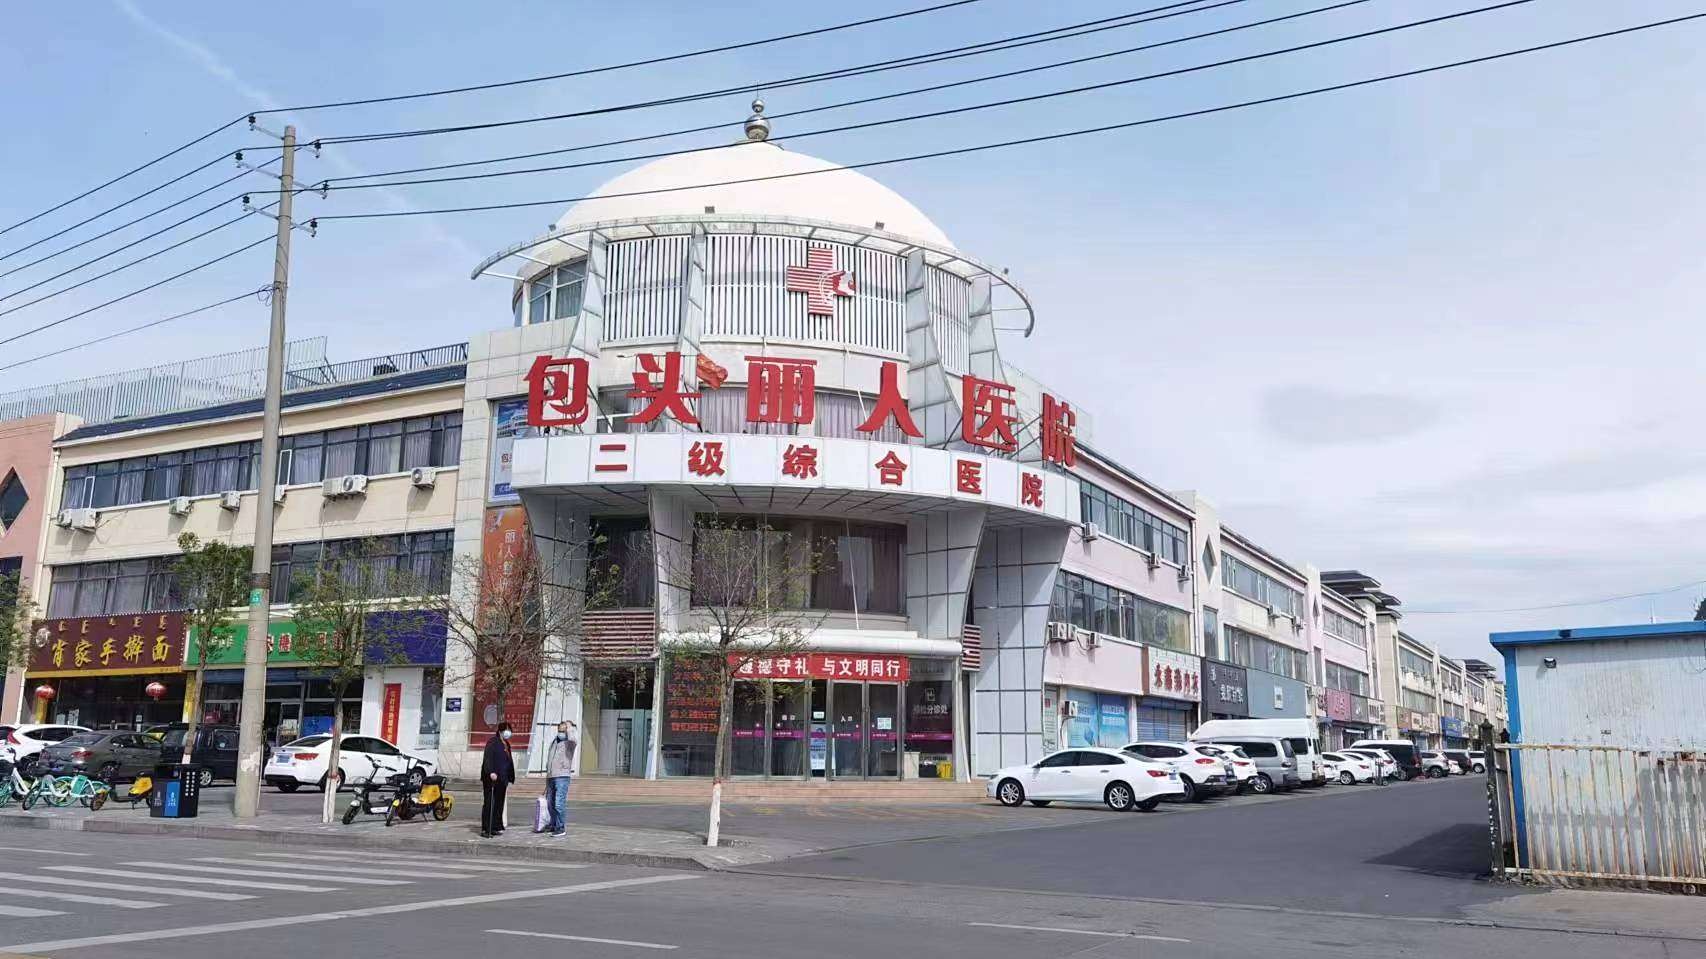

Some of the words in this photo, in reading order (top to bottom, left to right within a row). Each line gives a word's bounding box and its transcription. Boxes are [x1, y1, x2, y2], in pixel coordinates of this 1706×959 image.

[523, 352, 1076, 465] 包头丽人医院
[595, 441, 1044, 508] 二级综合医院
[822, 657, 901, 677] 与文明同行
